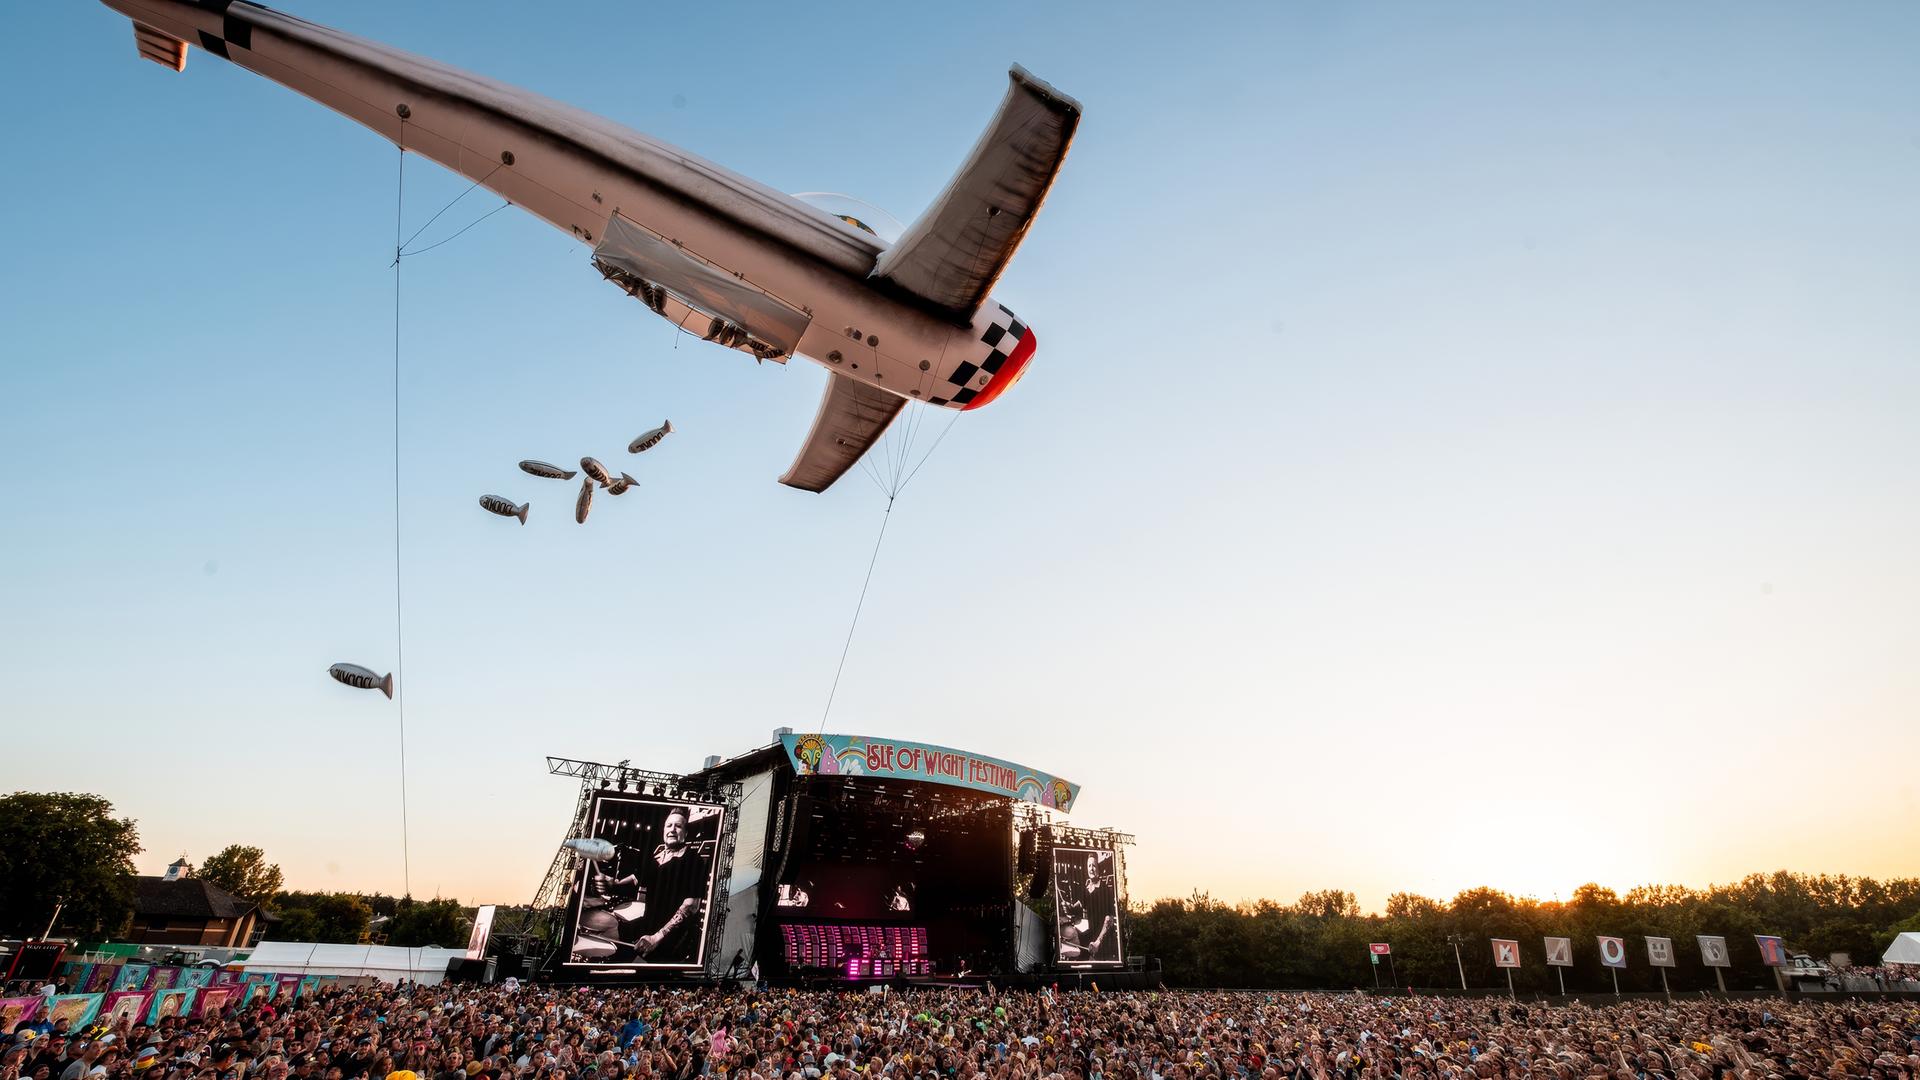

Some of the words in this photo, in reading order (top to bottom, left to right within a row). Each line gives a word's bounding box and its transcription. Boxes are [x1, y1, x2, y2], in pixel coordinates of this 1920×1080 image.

[866, 743, 895, 772] ISLE
[896, 747, 921, 771] OF
[922, 749, 966, 781] WIGHT
[968, 758, 1019, 792] FESTIVAL
